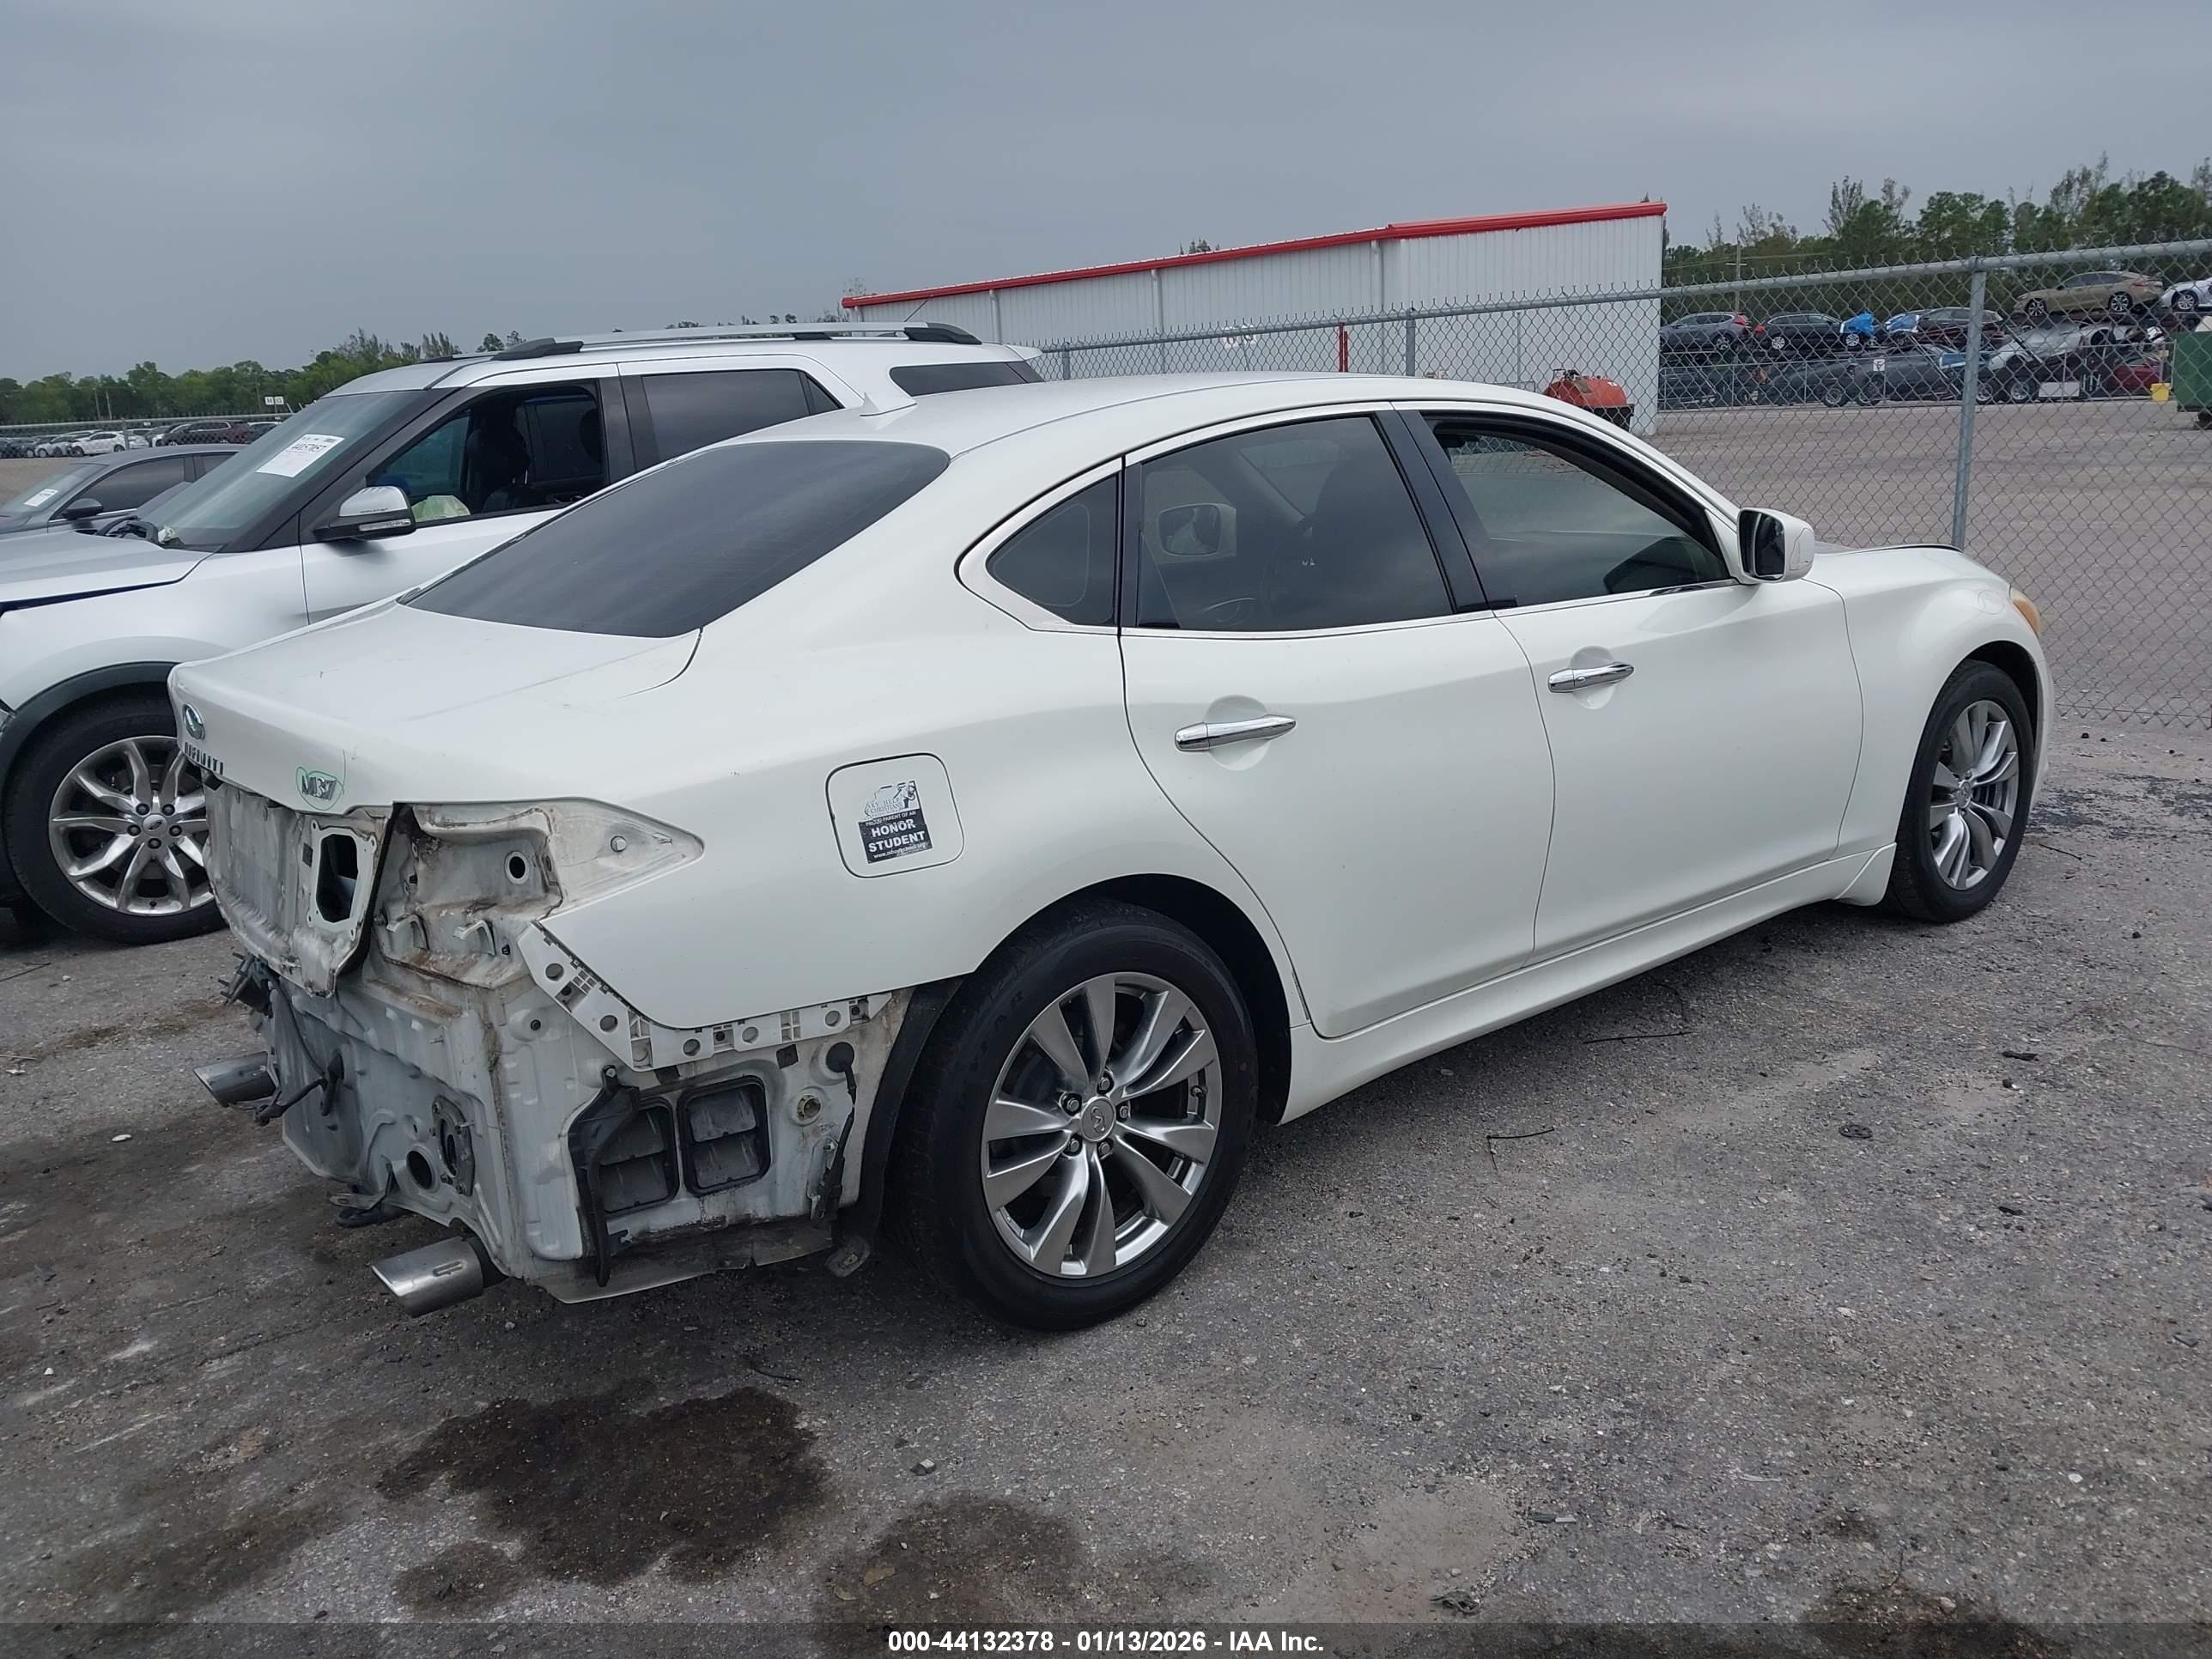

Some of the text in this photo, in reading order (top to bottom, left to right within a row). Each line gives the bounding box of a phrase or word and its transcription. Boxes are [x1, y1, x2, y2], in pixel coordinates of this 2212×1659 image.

[301, 775, 337, 800] M37
[866, 817, 882, 826] PROUD
[871, 818, 916, 837] HONOR
[868, 830, 925, 853] STUDENT
